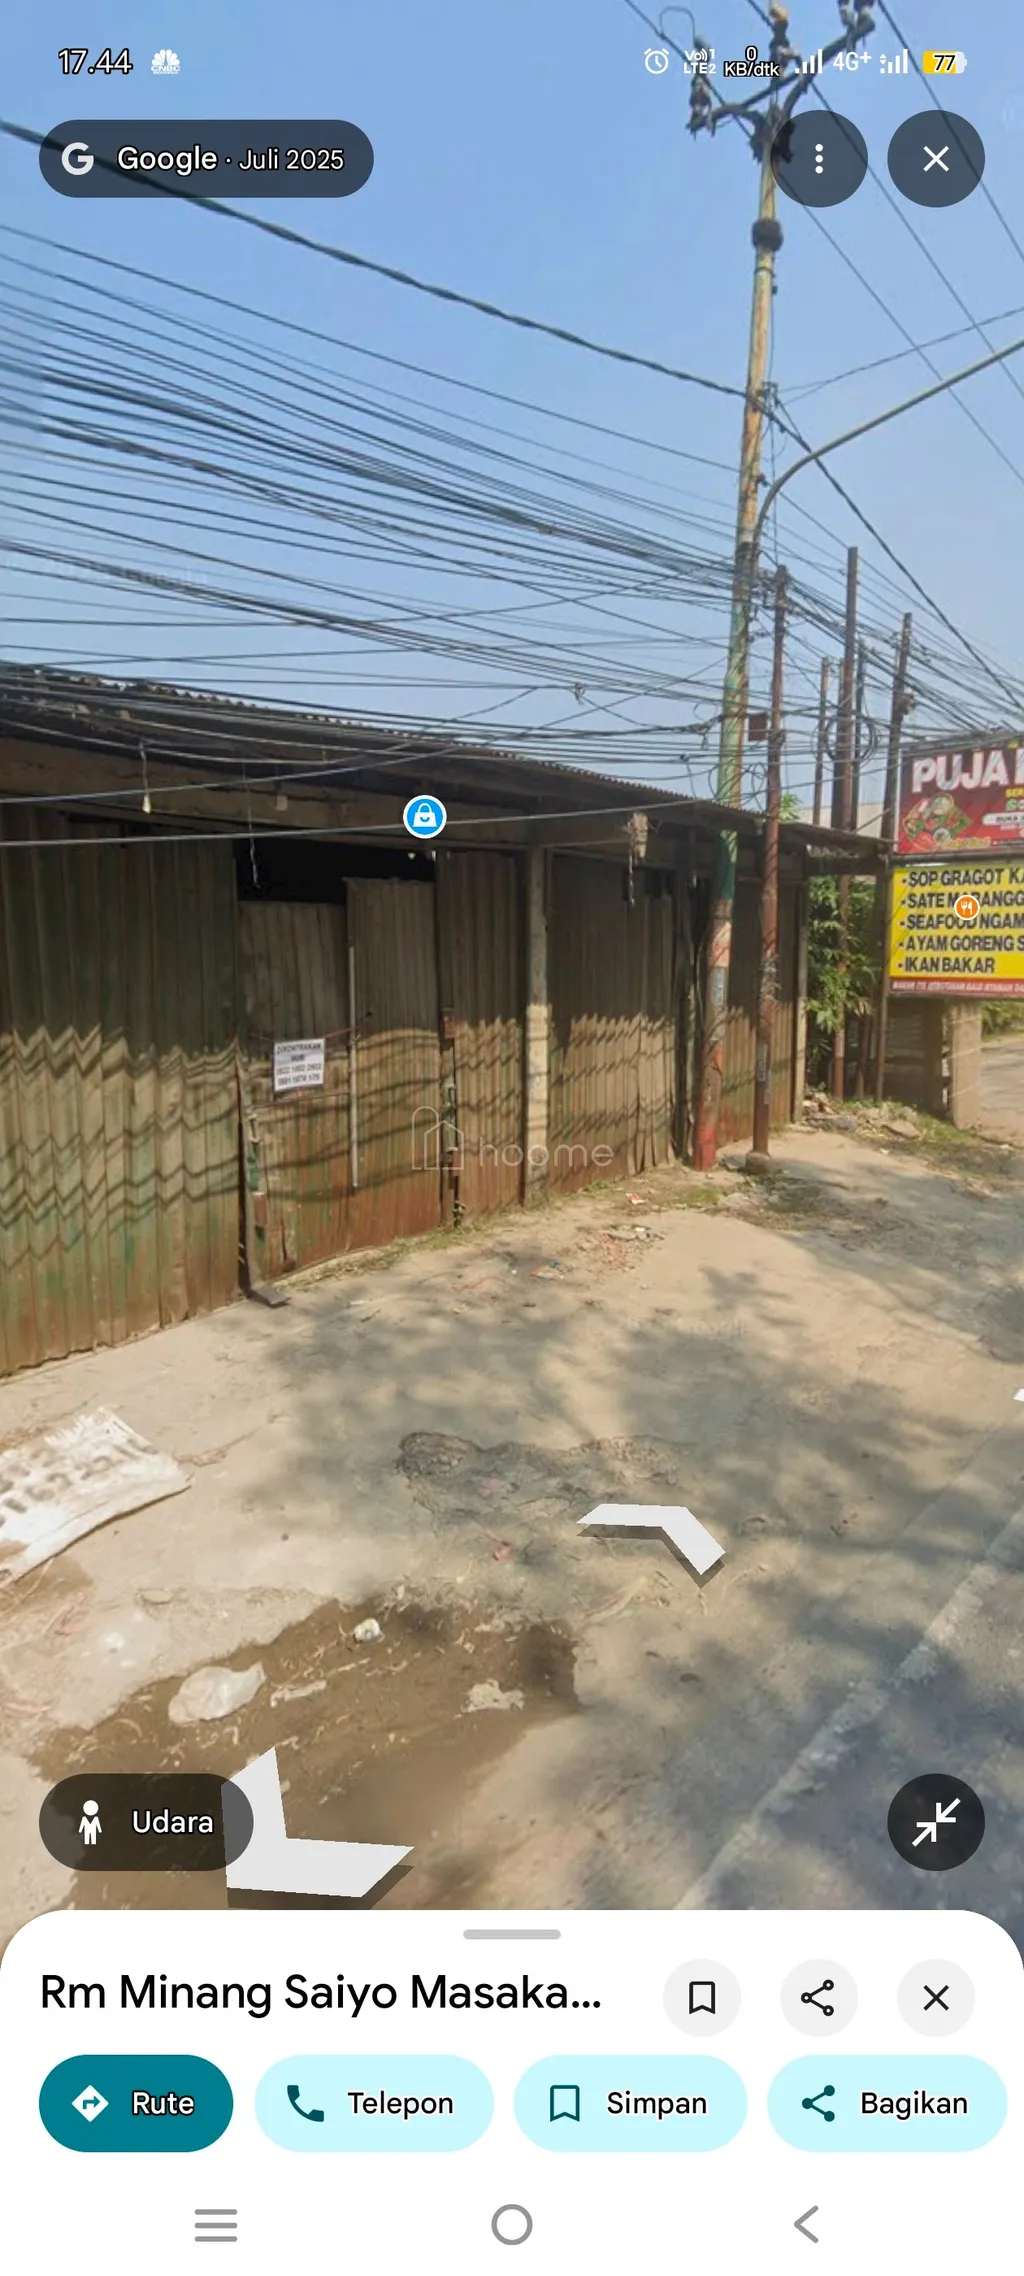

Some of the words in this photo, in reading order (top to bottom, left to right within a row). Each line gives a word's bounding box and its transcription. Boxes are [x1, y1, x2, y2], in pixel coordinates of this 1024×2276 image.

[912, 750, 1010, 793] PUJA
[908, 871, 938, 887] SOP
[941, 869, 1004, 885] GRAGOT
[907, 892, 944, 908] SATE
[907, 914, 976, 929] SEAFOOD
[906, 935, 947, 951] AYAM
[950, 935, 1015, 951] GORENG
[905, 957, 939, 972] IKAN
[942, 957, 995, 973] BAKAR
